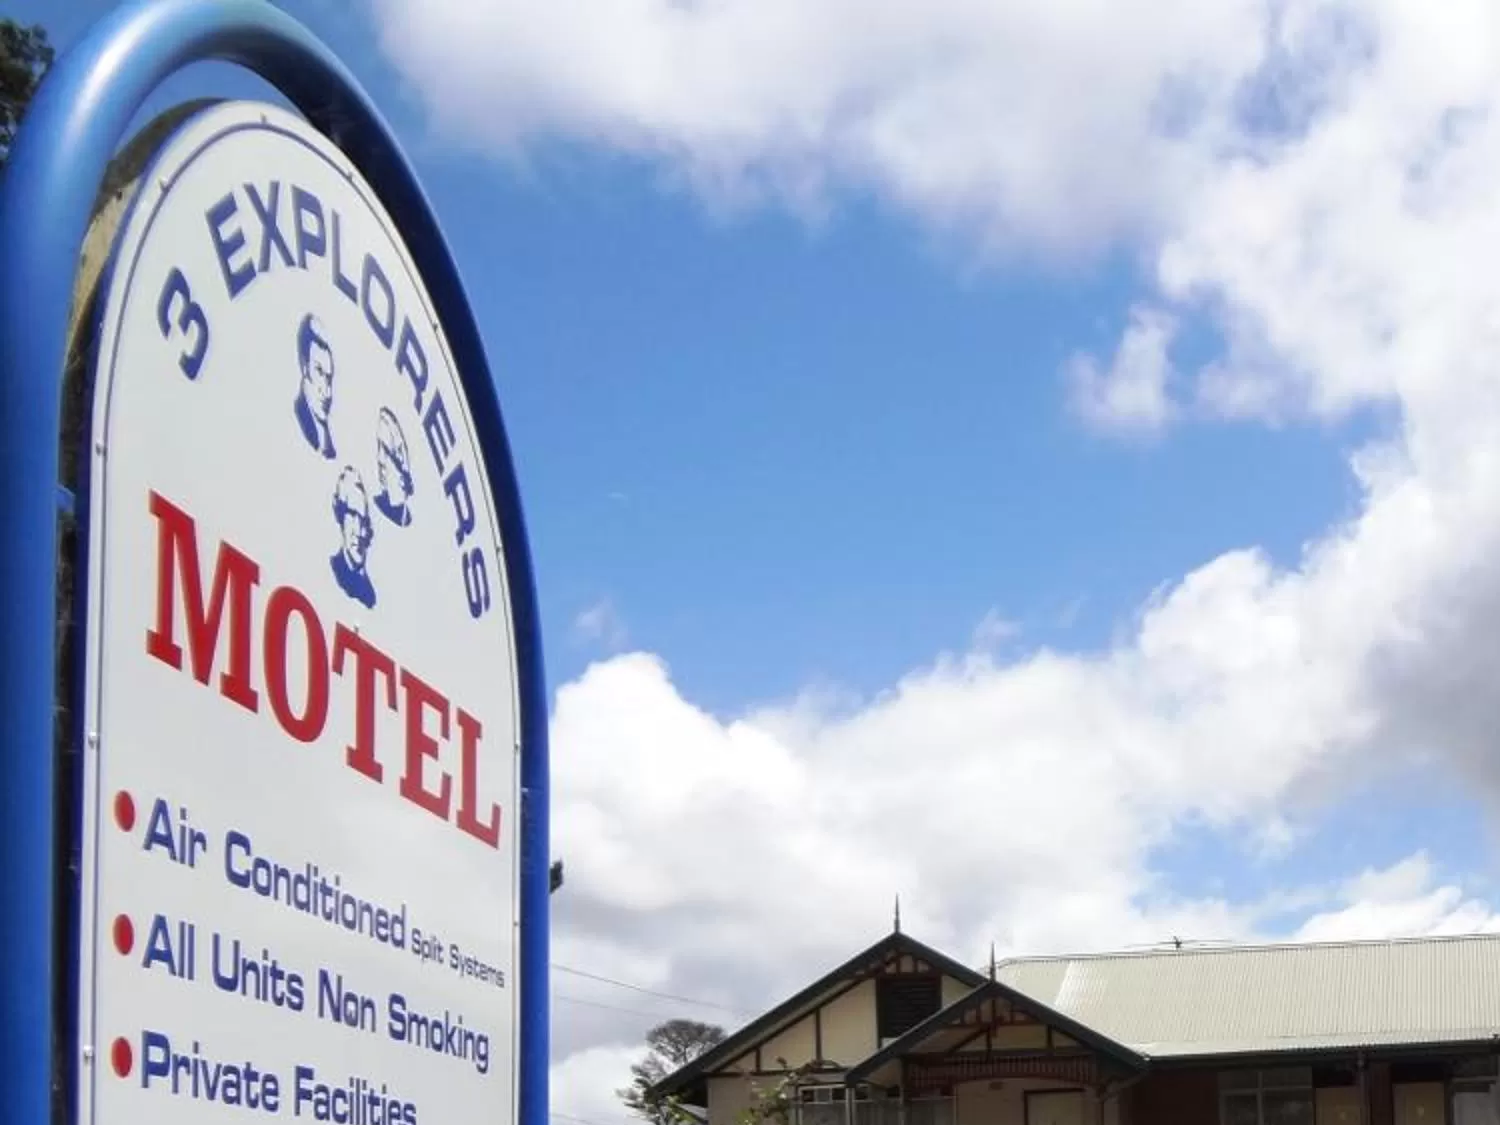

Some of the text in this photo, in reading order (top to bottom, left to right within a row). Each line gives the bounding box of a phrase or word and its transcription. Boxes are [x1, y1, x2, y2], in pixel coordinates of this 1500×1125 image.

[157, 181, 491, 619] 3 EXPLORERS
[146, 490, 501, 849] MOTEL
[143, 798, 506, 989] Air Conditioned Split Systems
[141, 1030, 280, 1113] Private
[142, 914, 489, 1075] All Units Non Smoking
